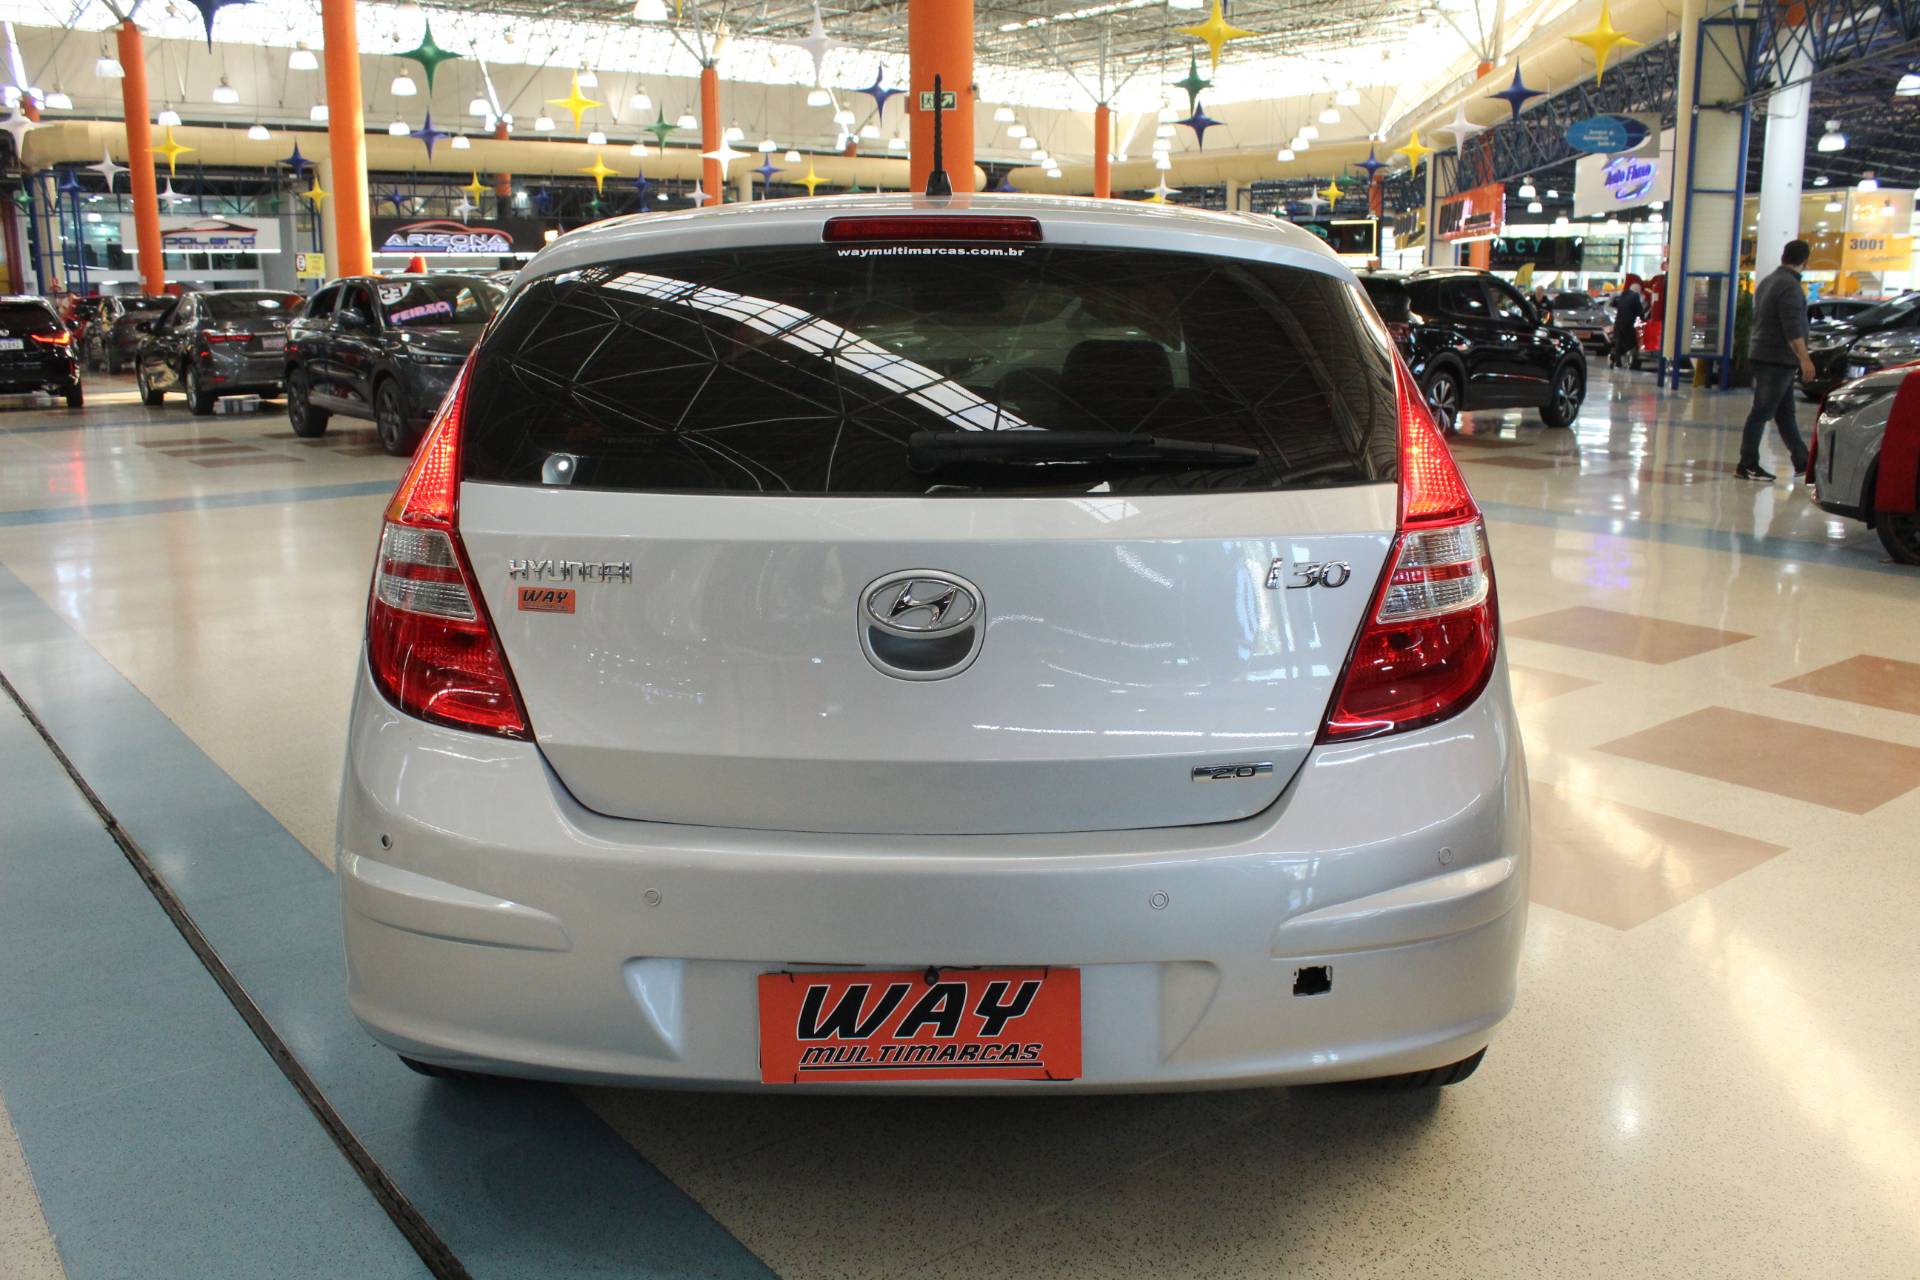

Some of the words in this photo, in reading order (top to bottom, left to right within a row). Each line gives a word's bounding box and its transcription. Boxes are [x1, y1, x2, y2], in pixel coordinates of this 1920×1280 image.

[384, 233, 510, 246] ARIZONA
[1850, 239, 1885, 250] 3001
[446, 244, 510, 253] MOTORS
[838, 246, 1025, 257] waymultimarcas.com.br
[509, 559, 633, 584] HYUNDAI
[522, 589, 569, 603] WAY
[1211, 765, 1256, 780] 2.0
[796, 980, 1042, 1040] WAY
[799, 1042, 1044, 1064] MULTIMARCAS
